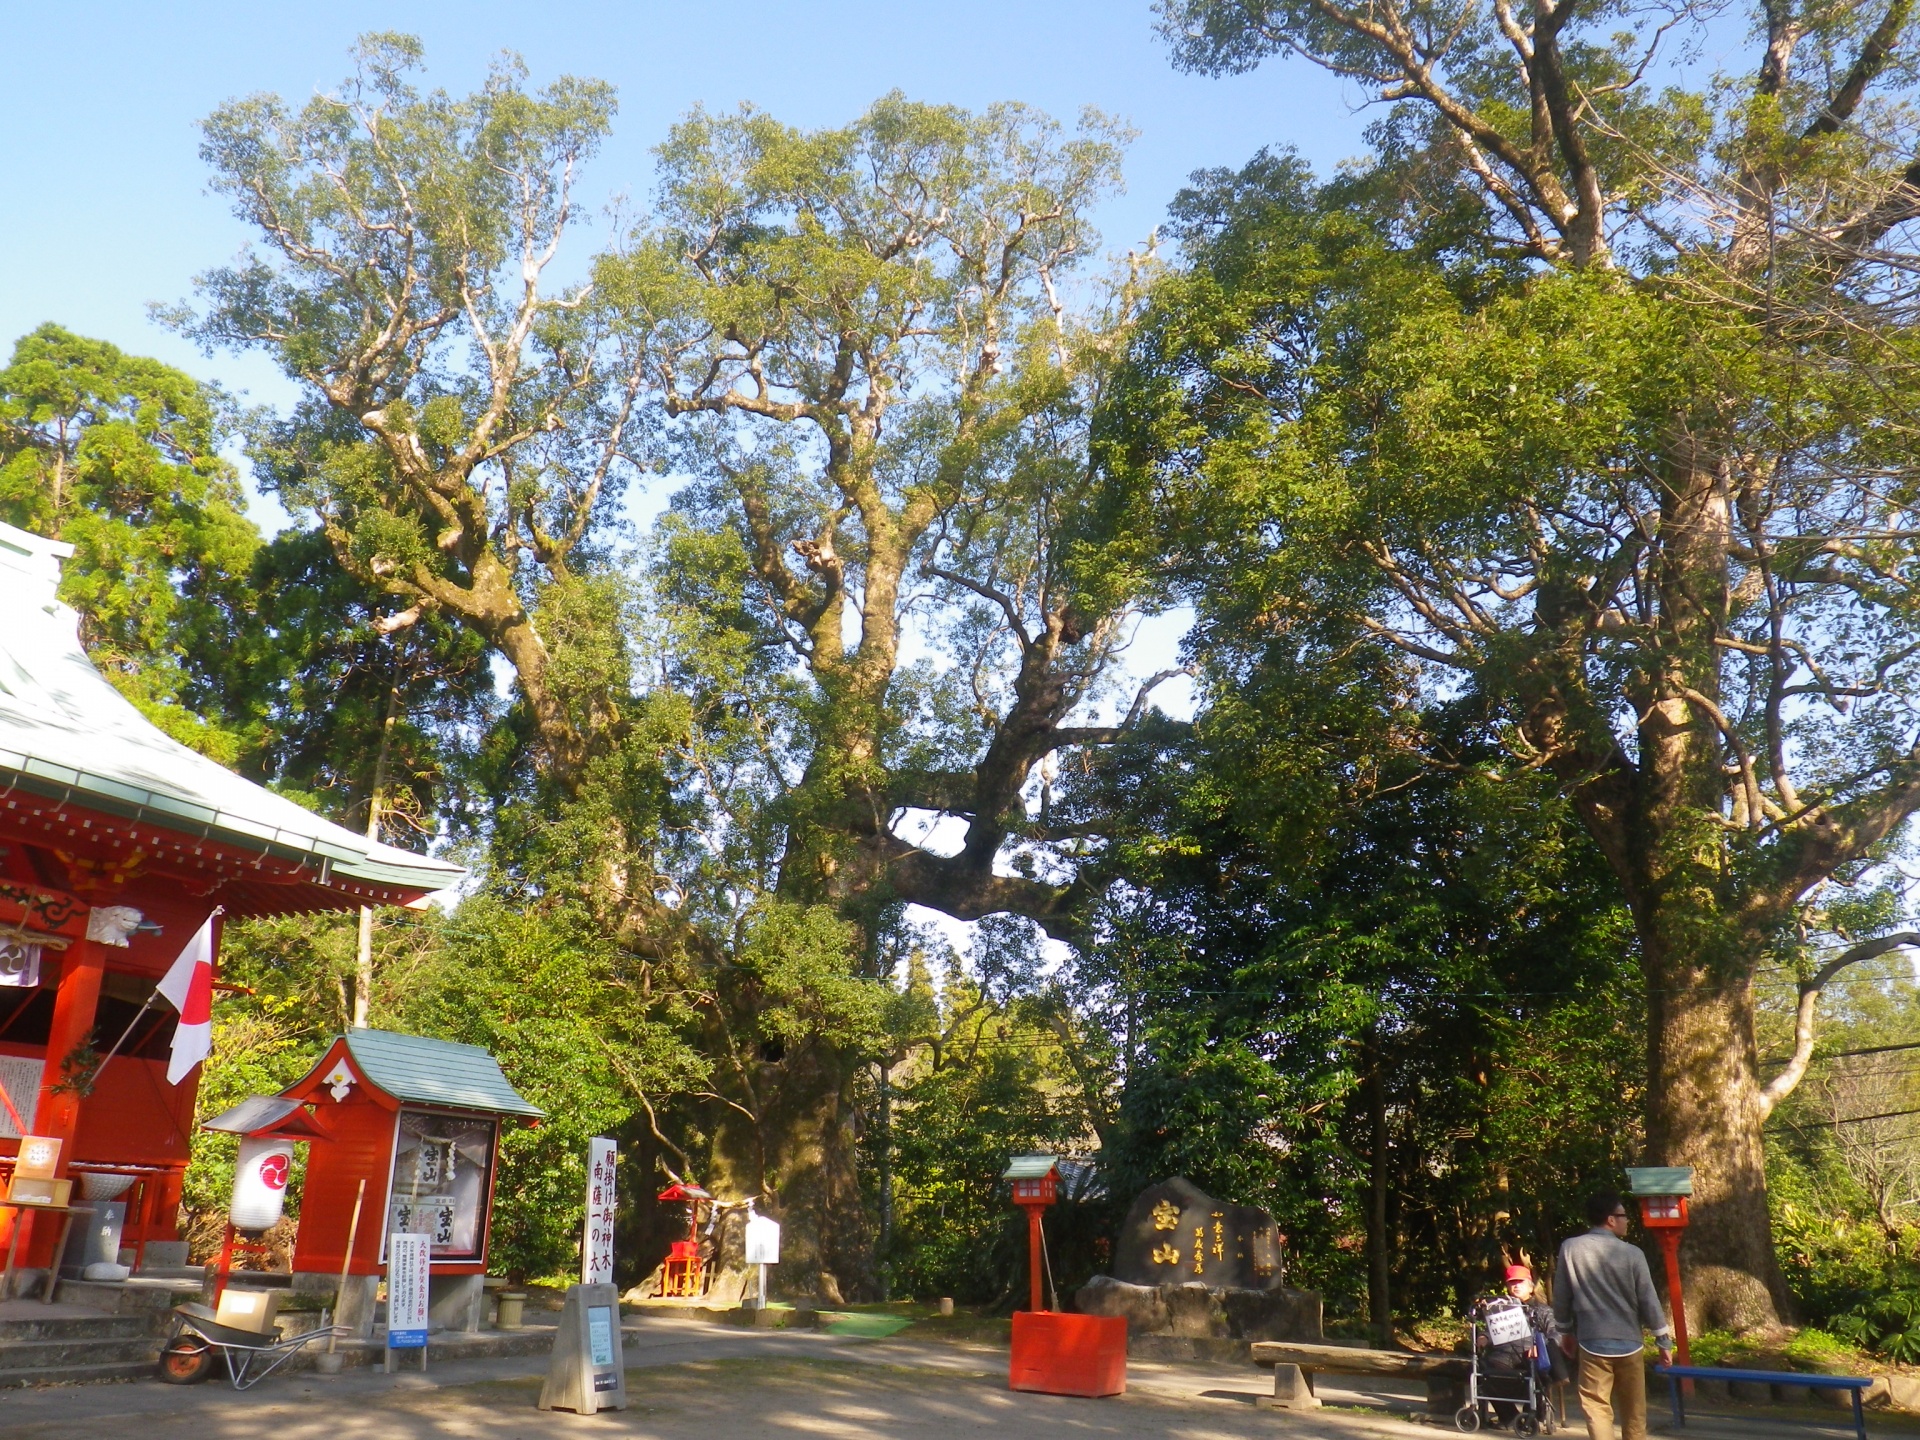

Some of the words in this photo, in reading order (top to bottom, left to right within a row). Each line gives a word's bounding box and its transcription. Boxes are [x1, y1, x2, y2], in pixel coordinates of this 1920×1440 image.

[101, 1209, 114, 1237] 奉納
[437, 1206, 453, 1243] 宝山
[601, 1150, 615, 1271] 願掛け御神木
